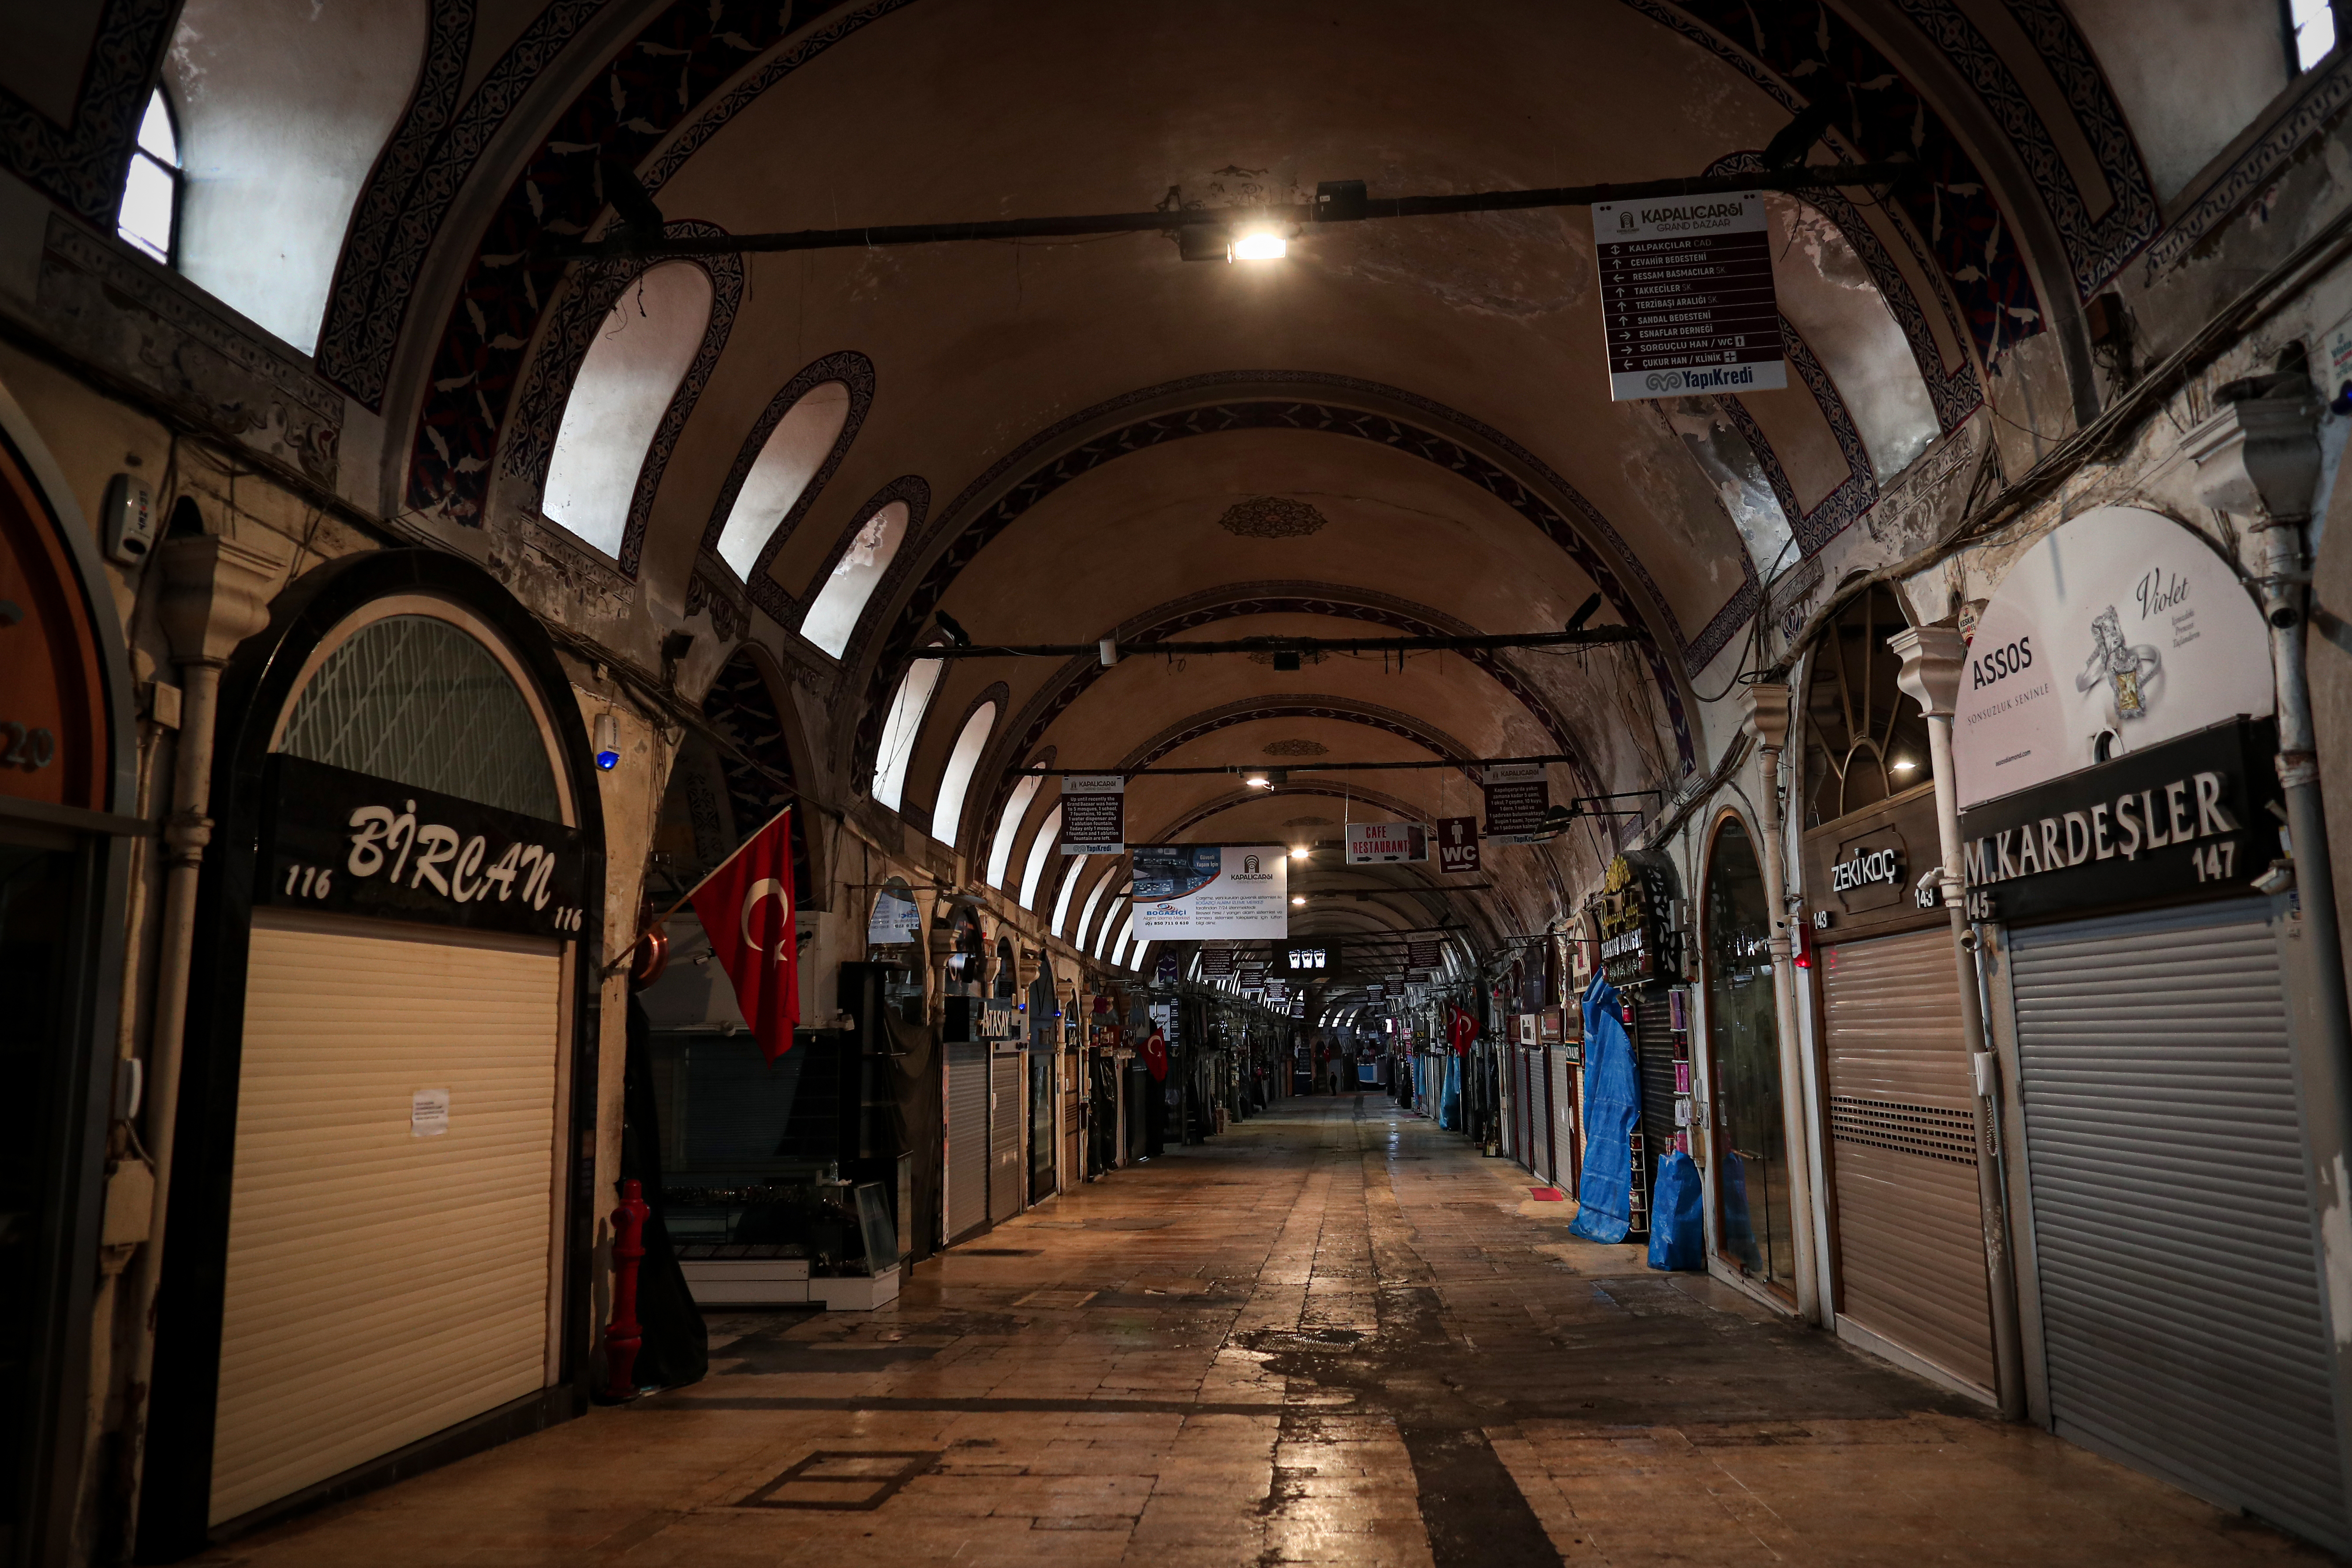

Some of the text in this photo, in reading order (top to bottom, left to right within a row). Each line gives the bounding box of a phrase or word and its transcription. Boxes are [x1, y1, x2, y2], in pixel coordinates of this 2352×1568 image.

[1657, 219, 1730, 232] GRAND BAZAAR
[1629, 240, 1691, 252] KALPAKÇILAR
[1630, 252, 1707, 266] CEVAHİR BEDESTENİ
[1633, 271, 1664, 281] RESSAM
[1666, 267, 1714, 278] BASMACILAR
[1634, 284, 1680, 295] TAKKECİLER
[1636, 299, 1675, 309] TERZİBAŞI
[1677, 296, 1706, 306] ARALIĞI
[1638, 310, 1711, 324] SANDAL BEDESTENİ
[1639, 323, 1713, 338] ESNAFLAR DERNEĞİ
[1640, 342, 1687, 352] SORGUÇLU
[1690, 340, 1708, 348] HAN
[1642, 358, 1669, 369] ÇUKUR
[1671, 356, 1687, 365] HAN
[1695, 353, 1721, 363] KLİNİK
[2136, 567, 2190, 621] Violet
[1973, 636, 2032, 690] ASSOS
[1967, 683, 2049, 726] SONSUZLUK SENİNLE
[1995, 750, 2031, 767] assosdiamond.com
[1365, 825, 1387, 838] CAFE
[1962, 771, 2240, 888] M.KARDEŞLER
[347, 799, 556, 912] BİRCAN
[1353, 840, 1408, 854] RESTAURANT
[1442, 845, 1477, 862] WC
[2192, 842, 2235, 883] 147
[284, 864, 332, 900] 116
[1914, 887, 1934, 909] 143
[1964, 891, 1989, 921] 145
[554, 906, 583, 932] 116
[1813, 910, 1828, 929] 143
[980, 1001, 1010, 1037] ATASAY
